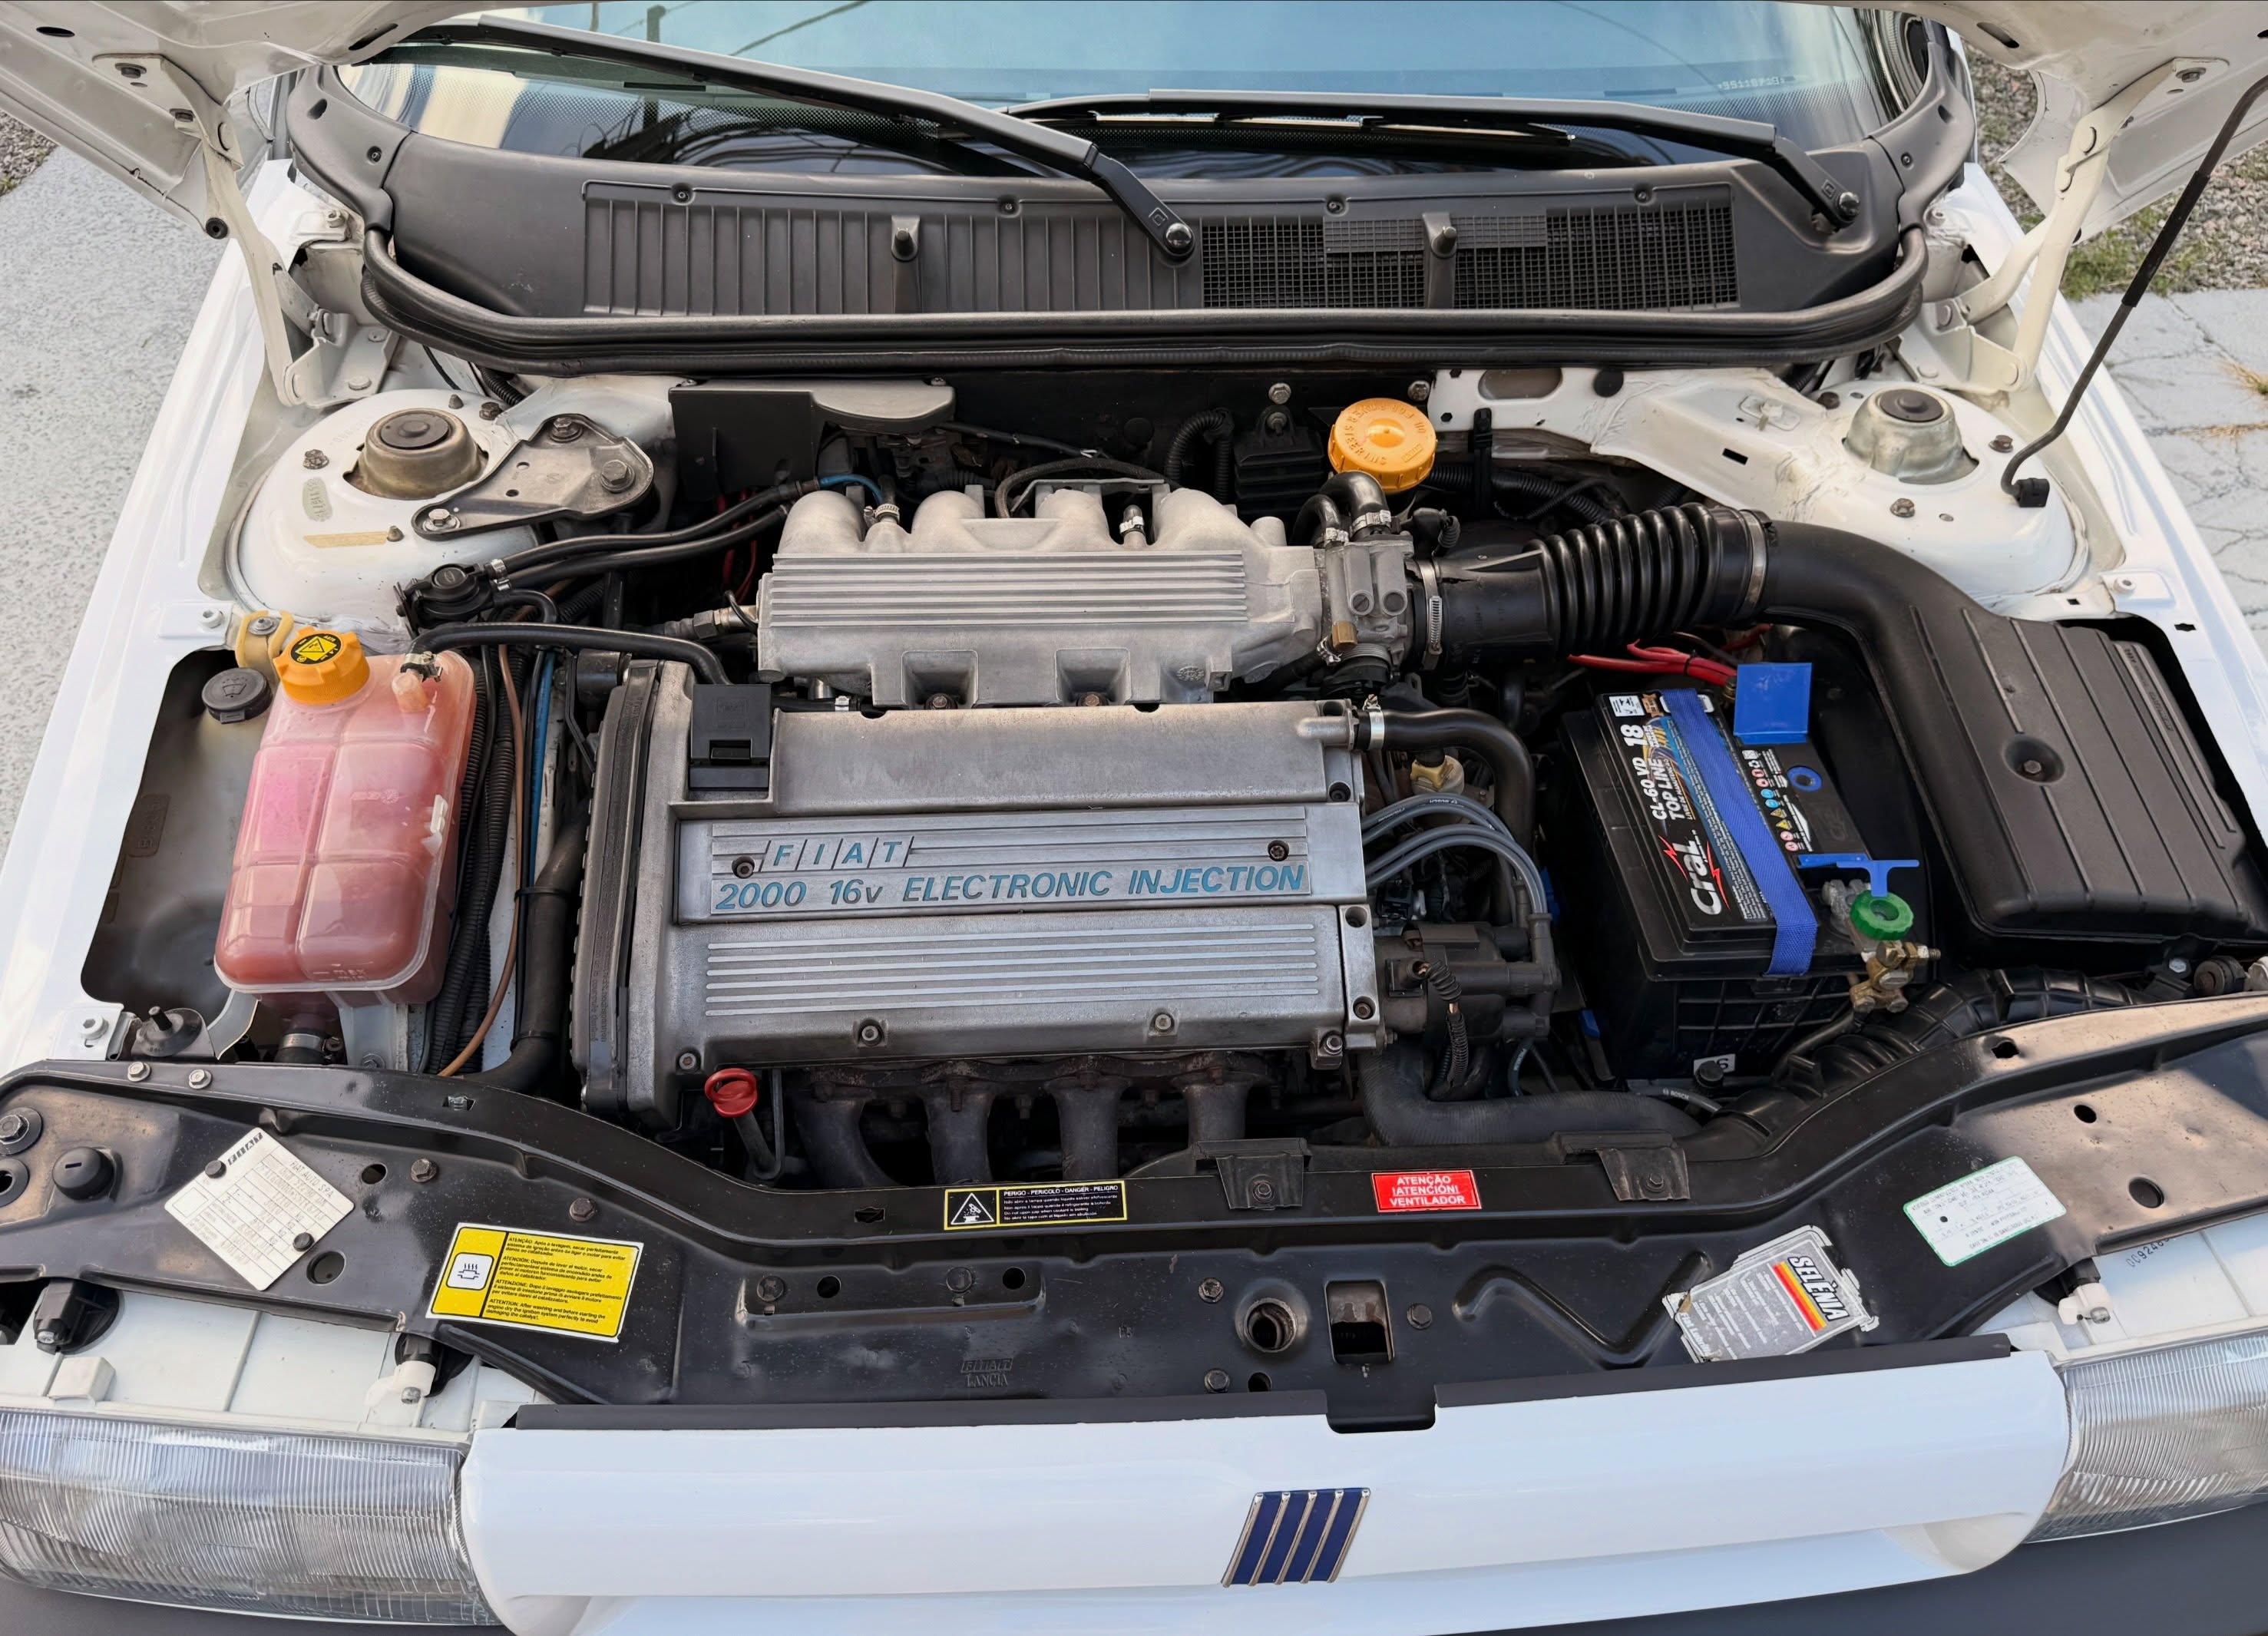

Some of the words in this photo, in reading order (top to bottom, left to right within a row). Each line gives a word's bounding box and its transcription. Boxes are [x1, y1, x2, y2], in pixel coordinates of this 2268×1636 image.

[1620, 724, 1645, 747] 18
[1634, 757, 1648, 776] VD
[1648, 758, 1677, 788] LINE
[1640, 778, 1667, 820] CL-60
[1662, 792, 1686, 820] TOP
[771, 839, 904, 868] FIAT
[716, 882, 806, 911] 2000
[829, 878, 883, 905] 16v
[903, 871, 1113, 902] ELECTRONIC
[1129, 863, 1305, 895] INJECTION
[1672, 840, 1722, 916] Cral
[1670, 1090, 1690, 1101] BOSCH
[227, 1132, 263, 1166] FIAT
[289, 1160, 306, 1174] FIAT
[302, 1170, 321, 1186] AUTO
[1397, 1175, 1451, 1186] ATENÇÃO
[1389, 1195, 1466, 1207] VENTILADOR
[966, 1373, 1009, 1388] LANCIA
